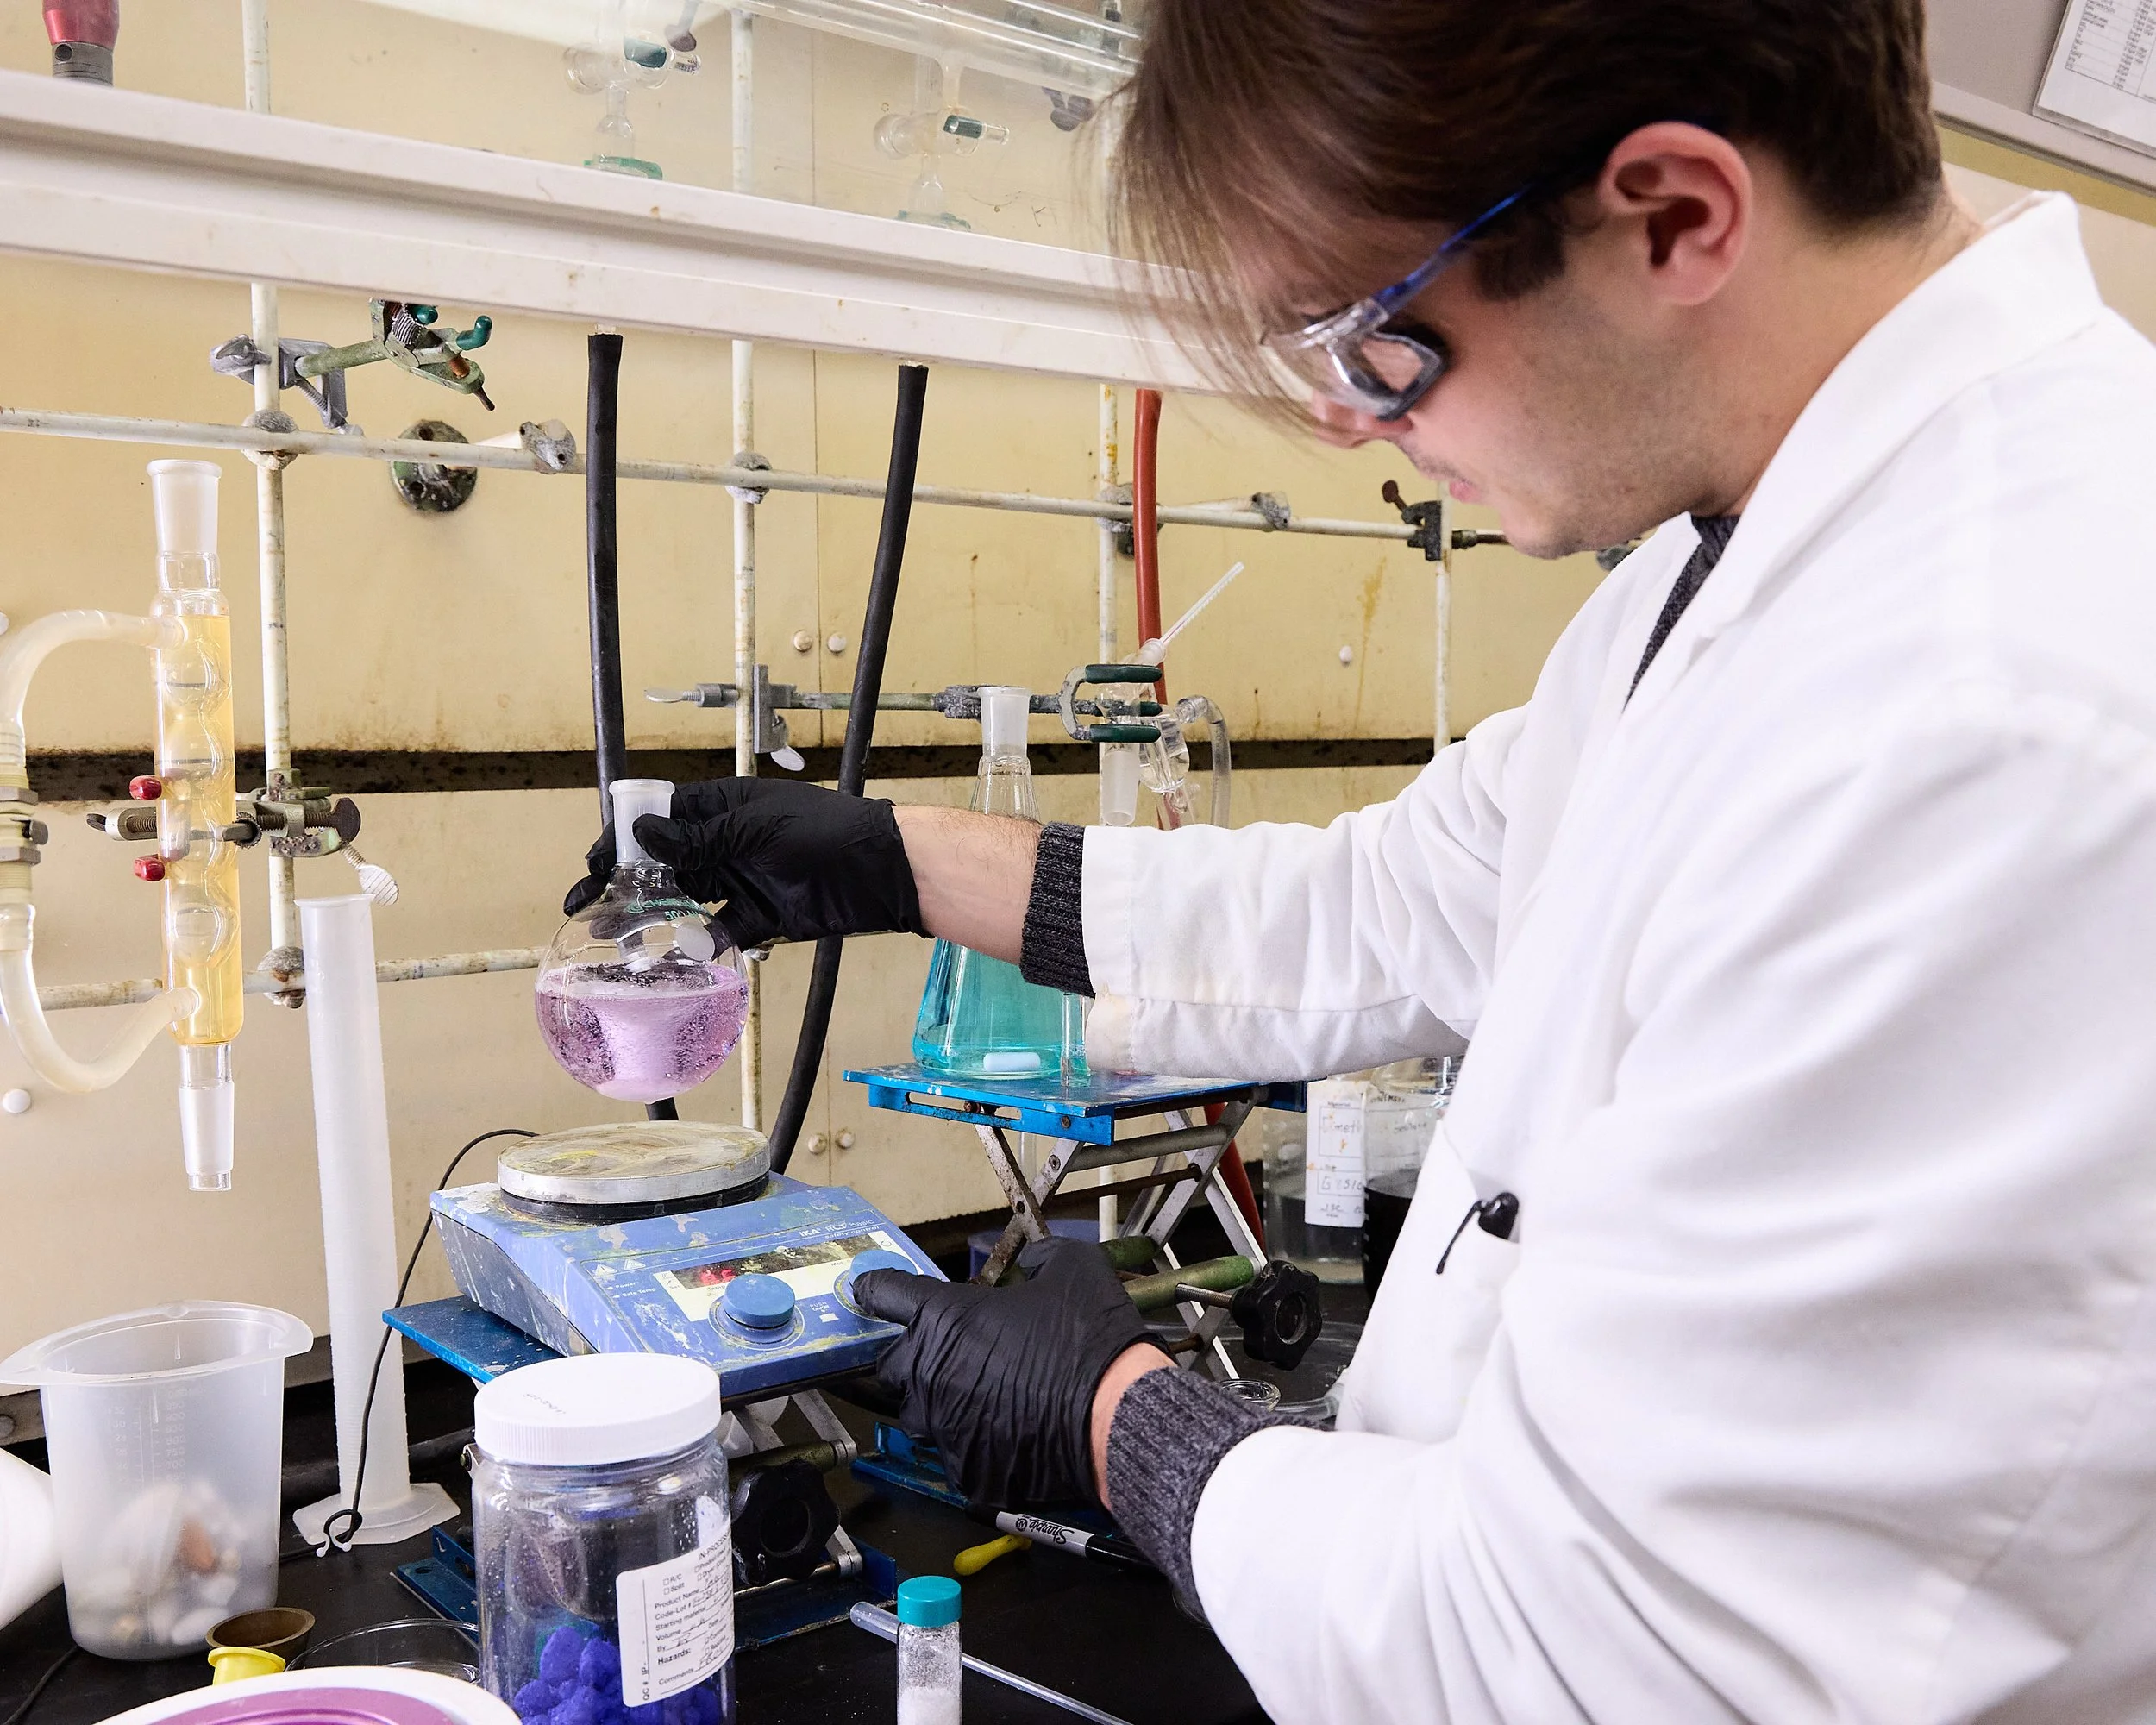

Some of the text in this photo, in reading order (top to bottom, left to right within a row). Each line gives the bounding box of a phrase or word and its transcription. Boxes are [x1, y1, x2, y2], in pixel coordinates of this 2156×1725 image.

[850, 1225, 880, 1235] control
[1029, 1518, 1075, 1544] Sharpie
[655, 1596, 681, 1610] Product
[682, 1589, 700, 1600] Name
[655, 1604, 687, 1621] Code-Lot
[655, 1617, 683, 1631] Starting
[683, 1606, 706, 1621] material
[655, 1629, 681, 1640] Volume
[656, 1645, 667, 1653] By
[657, 1647, 692, 1665] Hazards:
[658, 1667, 695, 1686] Comments
